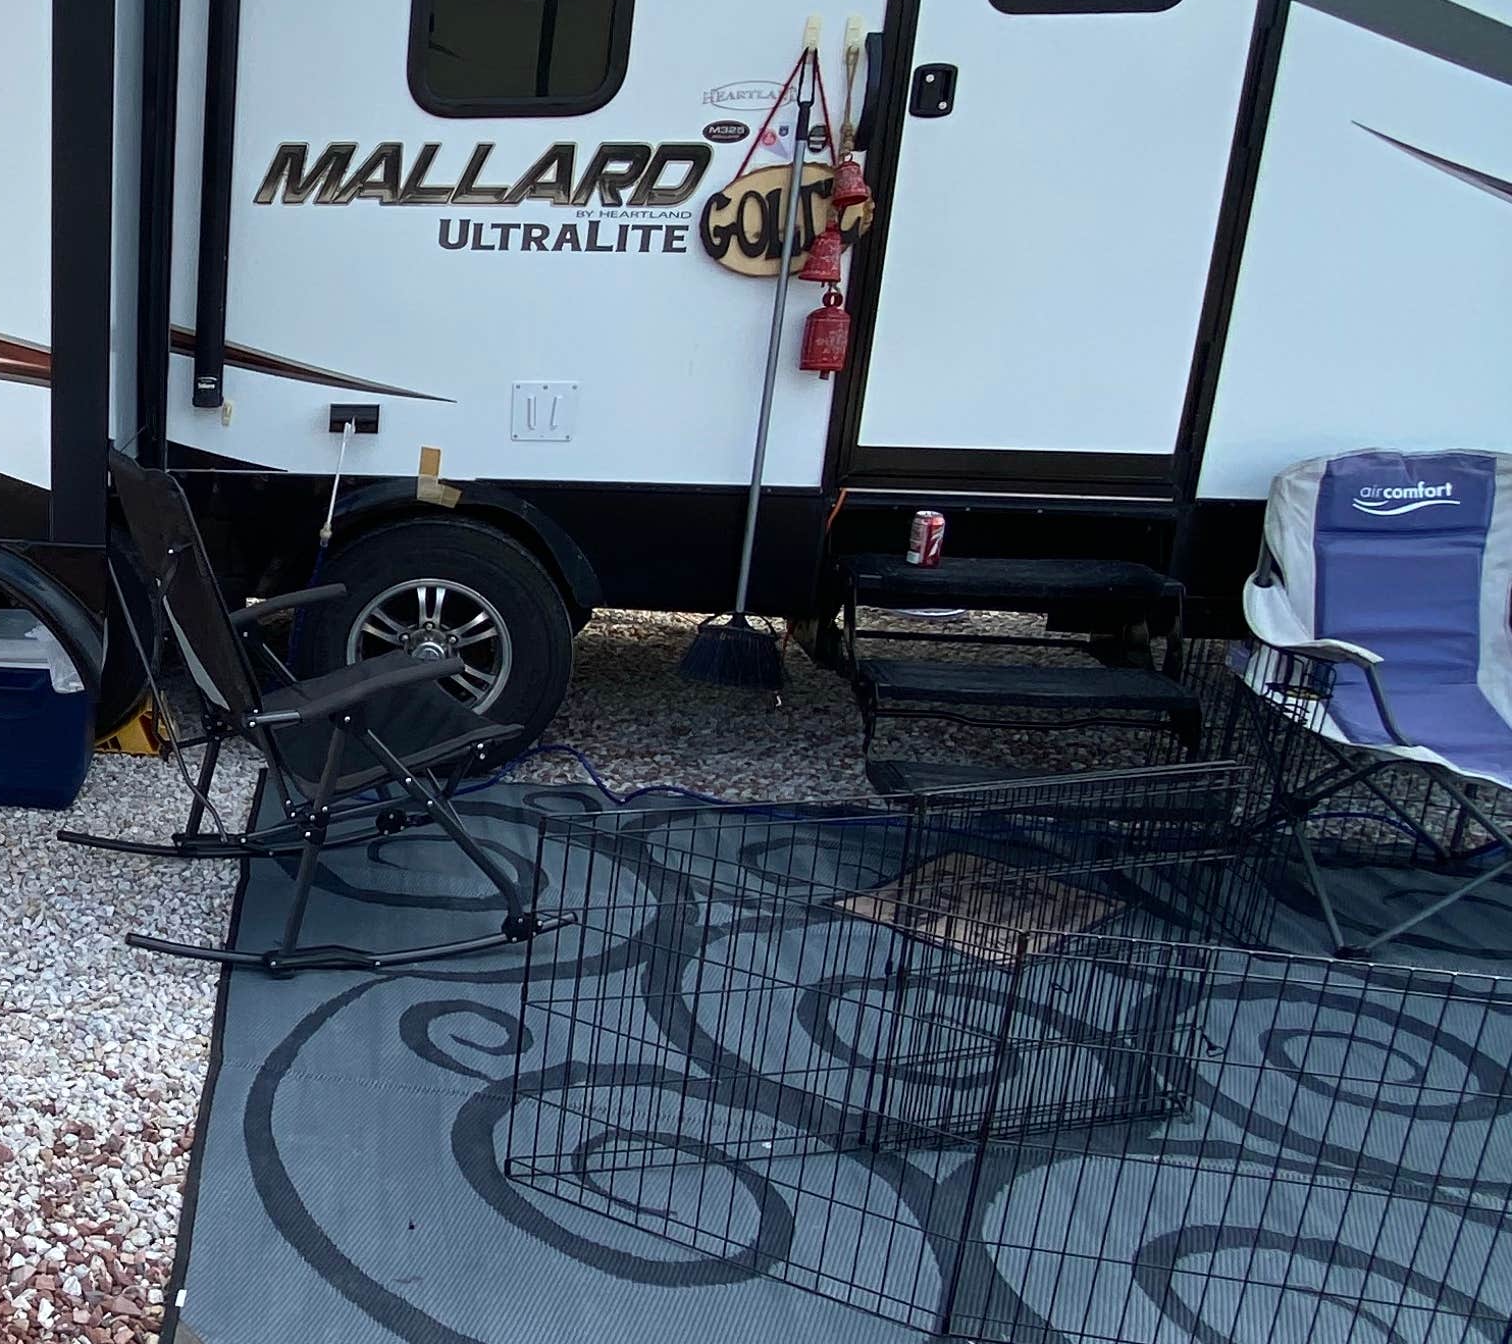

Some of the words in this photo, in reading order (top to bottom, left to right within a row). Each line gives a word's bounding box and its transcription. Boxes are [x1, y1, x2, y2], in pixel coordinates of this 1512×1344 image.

[253, 142, 714, 207] MALLARD
[575, 209, 594, 219] BY
[599, 210, 692, 219] HEARTLAND
[439, 218, 689, 253] ULTRALITE
